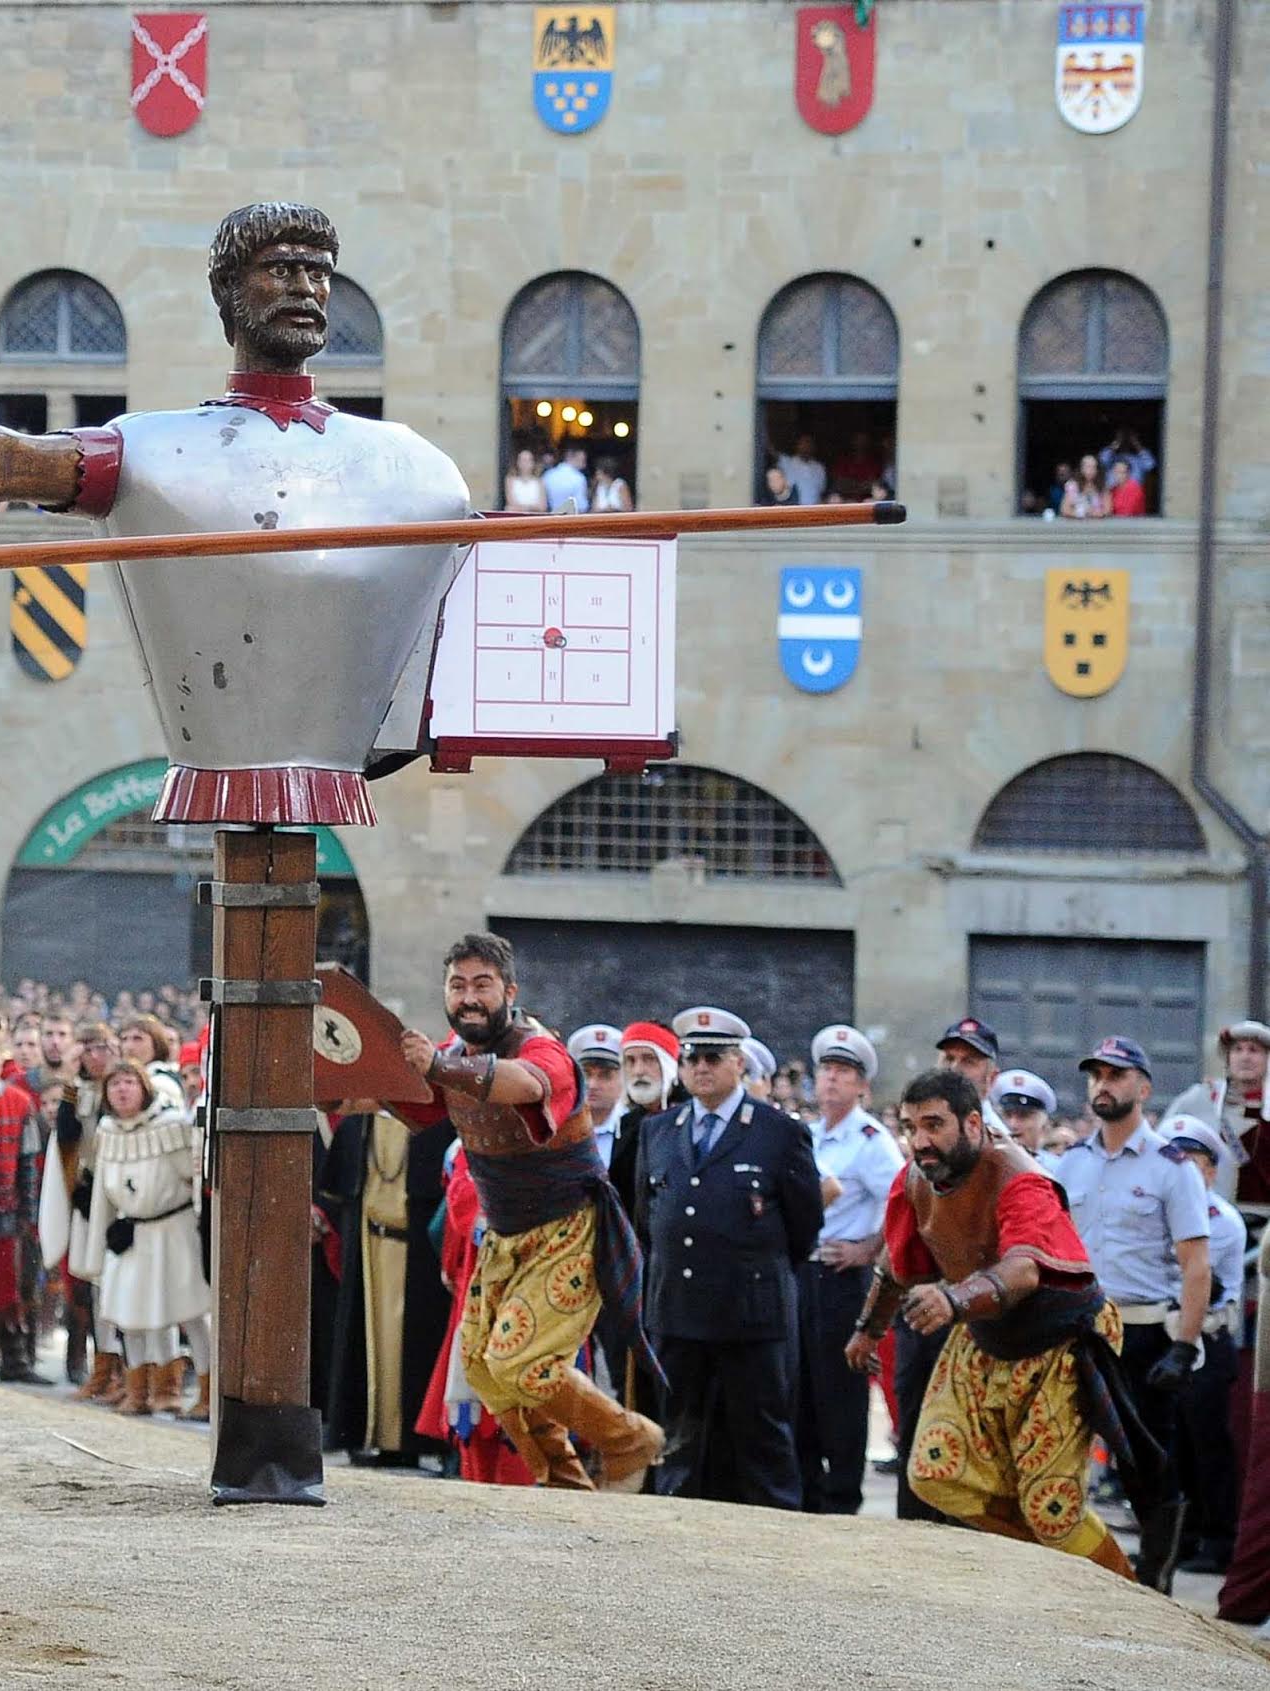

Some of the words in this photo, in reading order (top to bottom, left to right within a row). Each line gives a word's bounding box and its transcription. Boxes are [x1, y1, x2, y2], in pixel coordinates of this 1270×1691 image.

[548, 596, 560, 606] IV
[591, 596, 603, 606] III
[590, 634, 602, 644] IV
[44, 810, 86, 848] La
